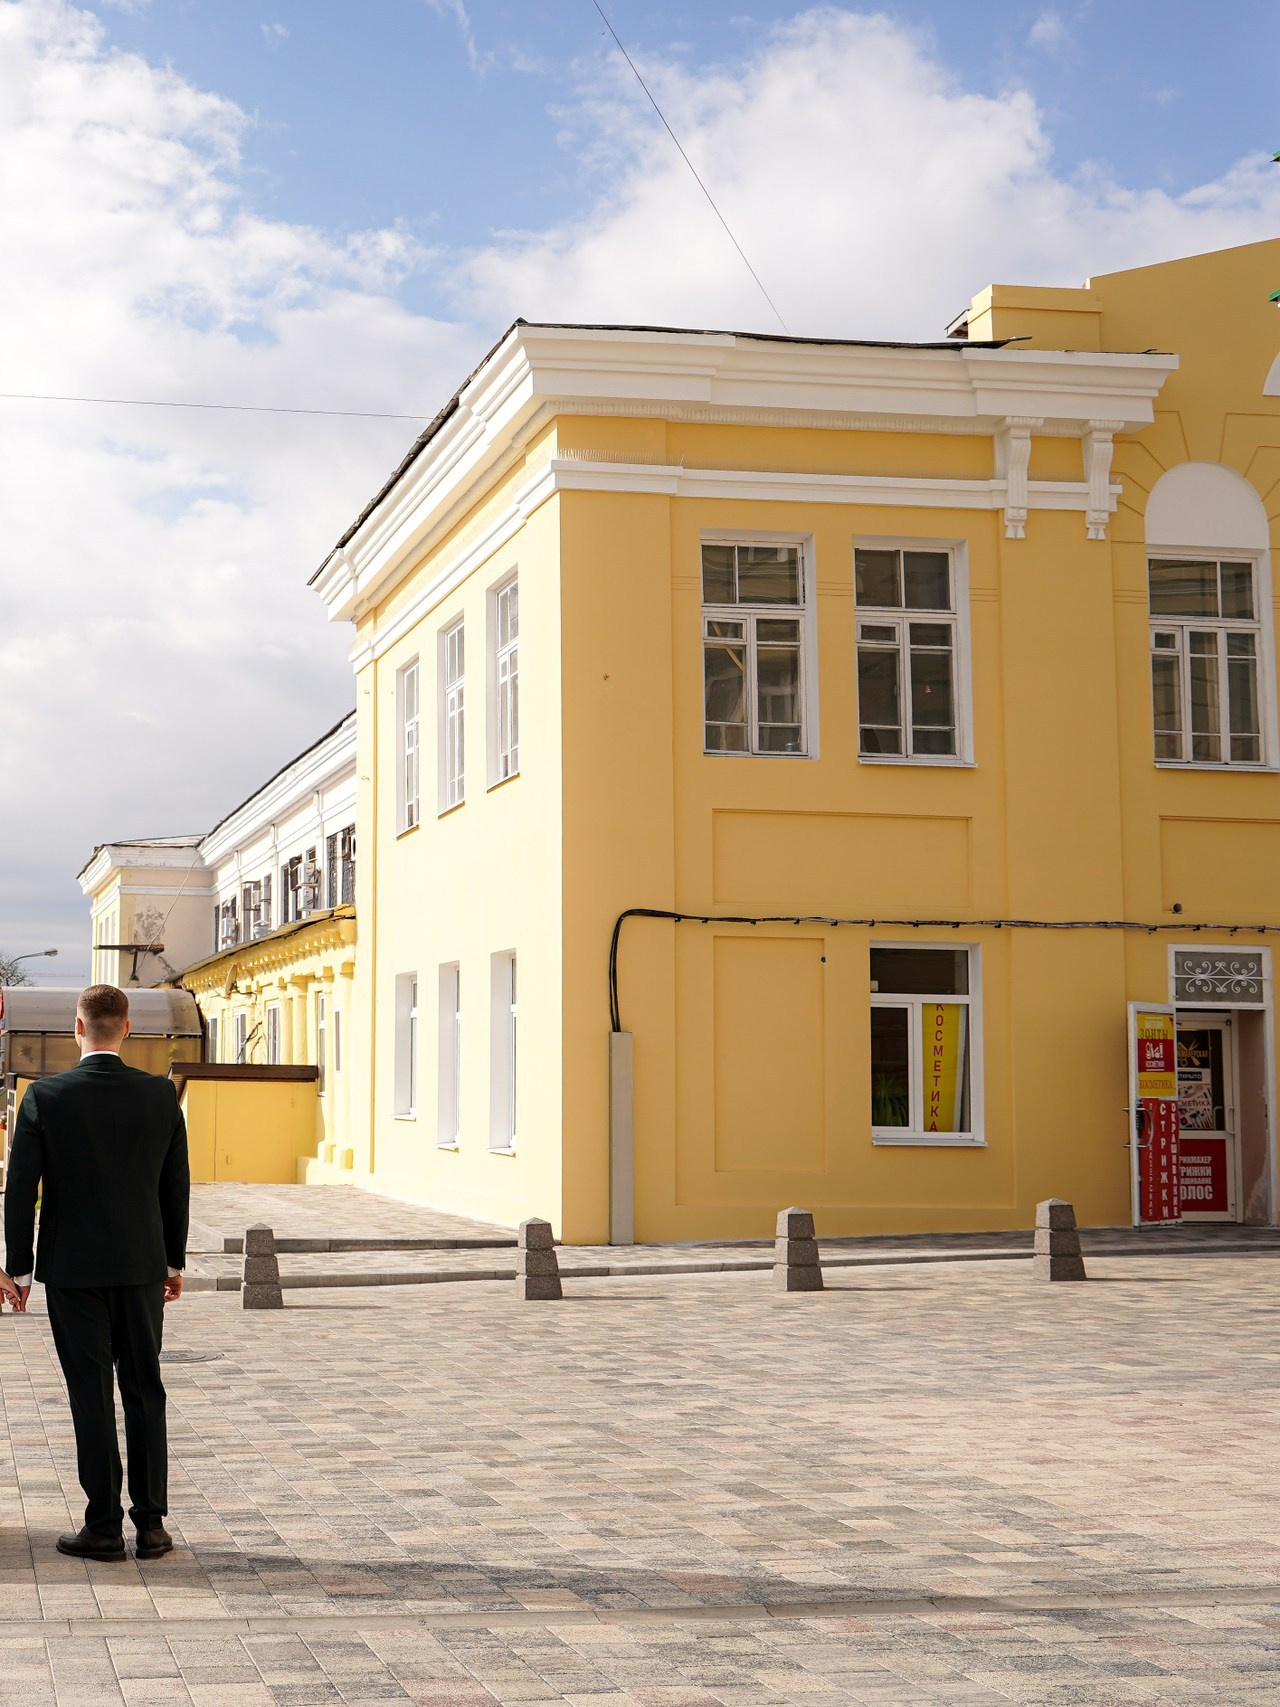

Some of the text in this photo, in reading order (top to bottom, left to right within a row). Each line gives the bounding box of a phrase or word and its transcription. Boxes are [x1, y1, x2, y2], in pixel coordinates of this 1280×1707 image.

[929, 1004, 945, 1132] КОСМЕТИКА
[1159, 1103, 1168, 1218] СТРИЖКИ
[1170, 1102, 1178, 1216] ОКРАШИВАНИЕ
[1180, 1185, 1213, 1200] ОЛОС
